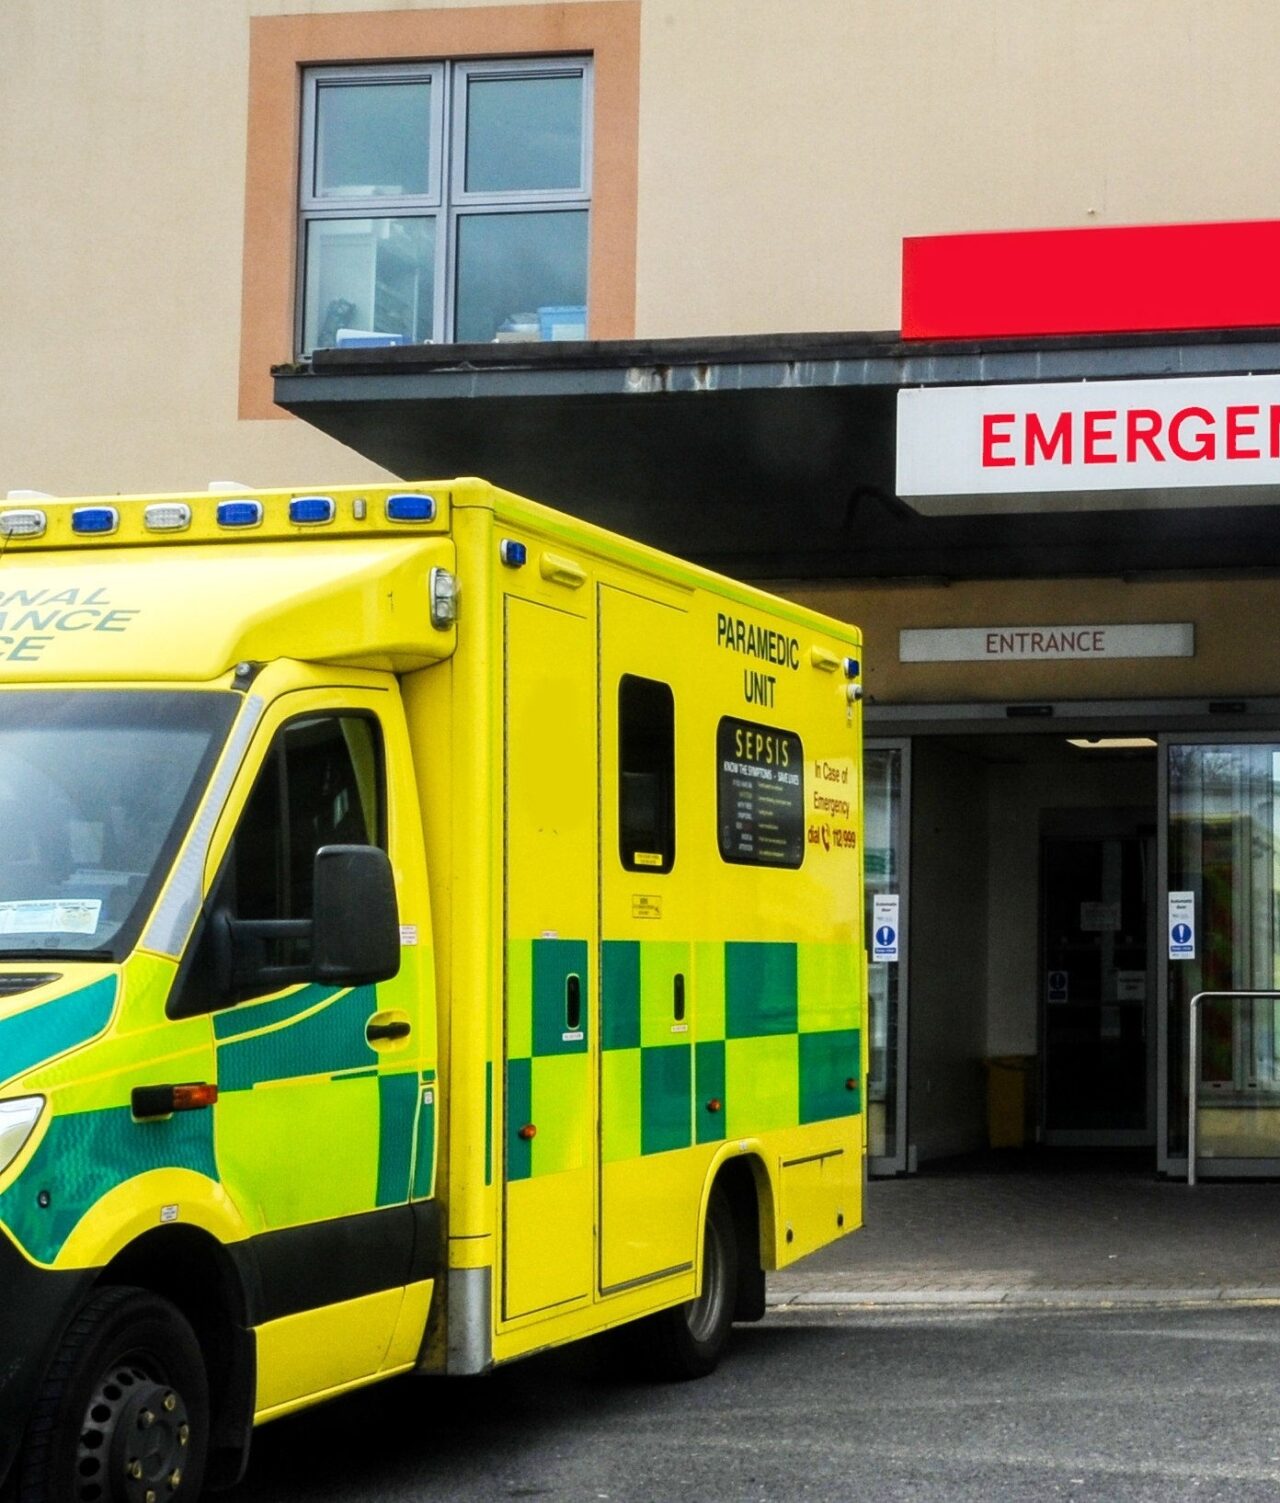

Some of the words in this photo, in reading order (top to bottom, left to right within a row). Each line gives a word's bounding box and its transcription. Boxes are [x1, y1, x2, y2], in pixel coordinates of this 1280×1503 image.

[717, 612, 800, 671] PARAMEDIC
[985, 630, 1106, 654] ENTRANCE
[743, 668, 777, 708] UNIT
[735, 728, 790, 768] SEPSIS
[814, 760, 822, 778] In
[822, 761, 840, 783] Case
[841, 767, 848, 784] of
[813, 790, 850, 820] Emergency
[807, 825, 820, 844] dial
